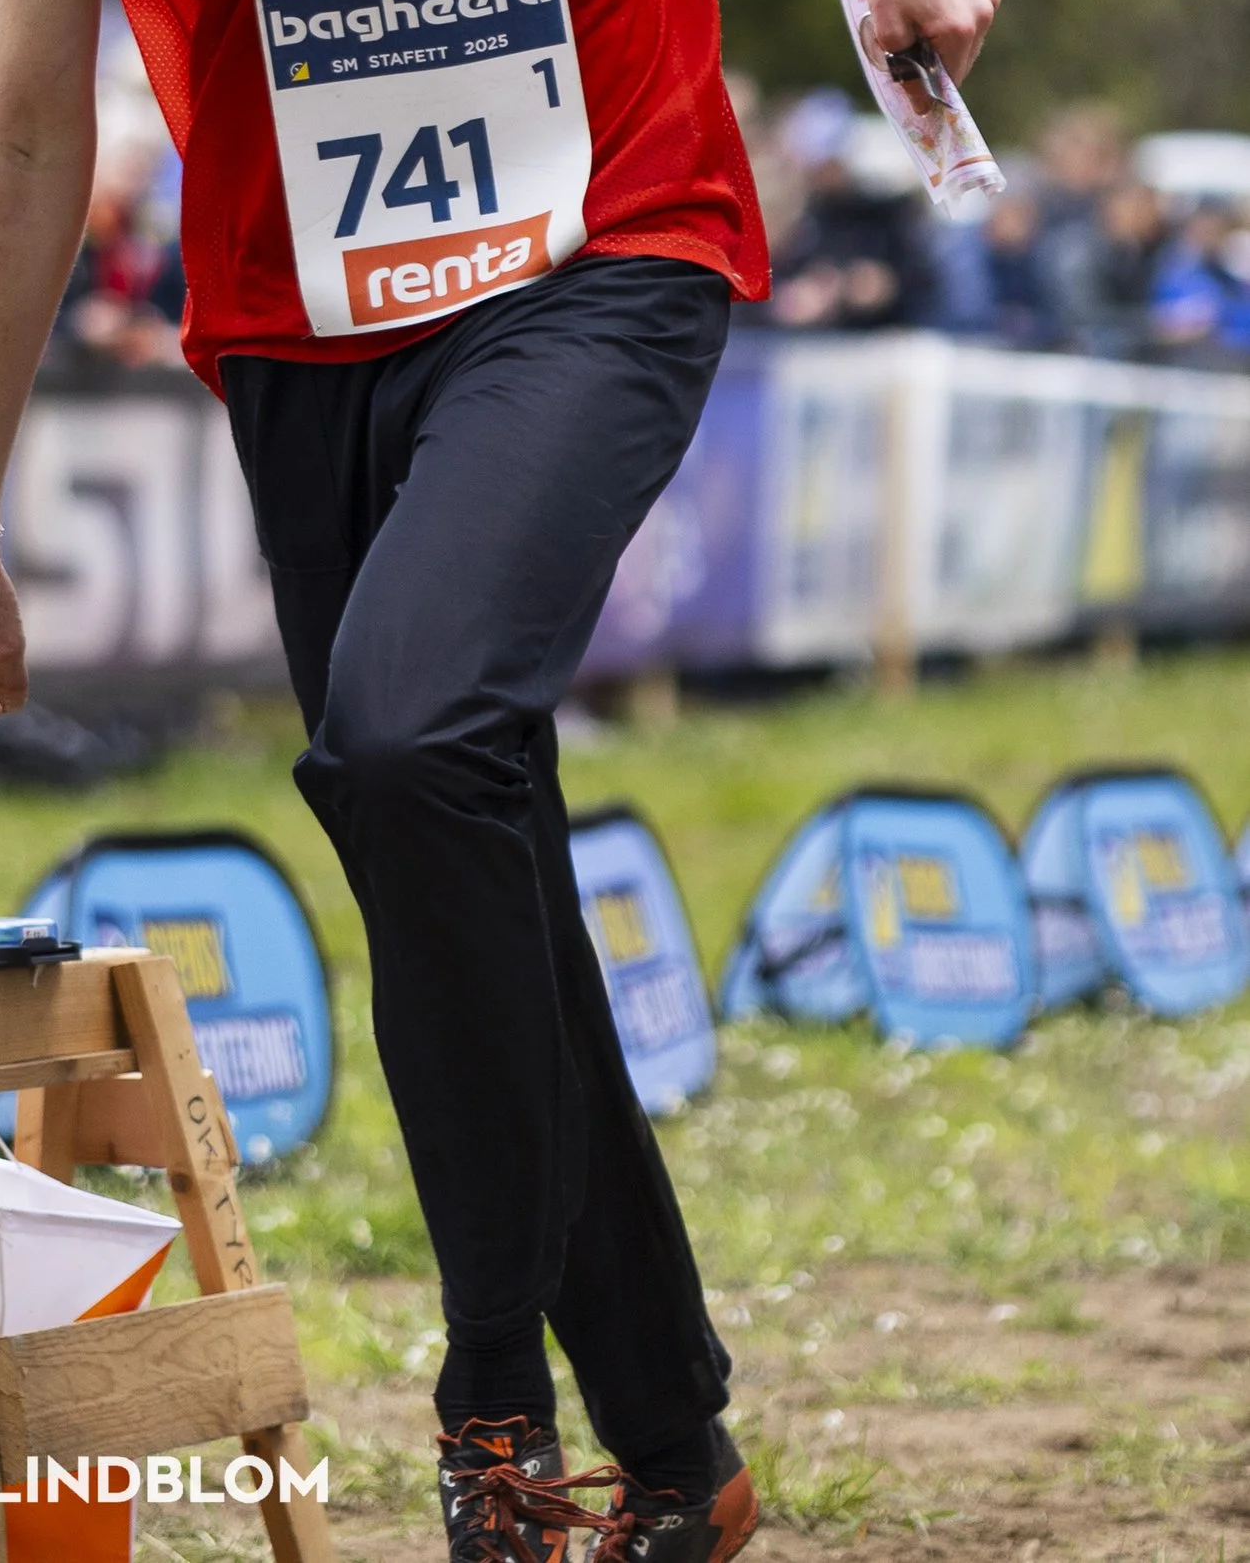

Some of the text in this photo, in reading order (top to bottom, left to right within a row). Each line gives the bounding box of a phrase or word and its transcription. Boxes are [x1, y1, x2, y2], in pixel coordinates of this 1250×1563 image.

[332, 34, 510, 74] SM STAFETT 2025
[531, 57, 561, 109] 1
[316, 117, 499, 239] 741
[367, 235, 531, 309] renta
